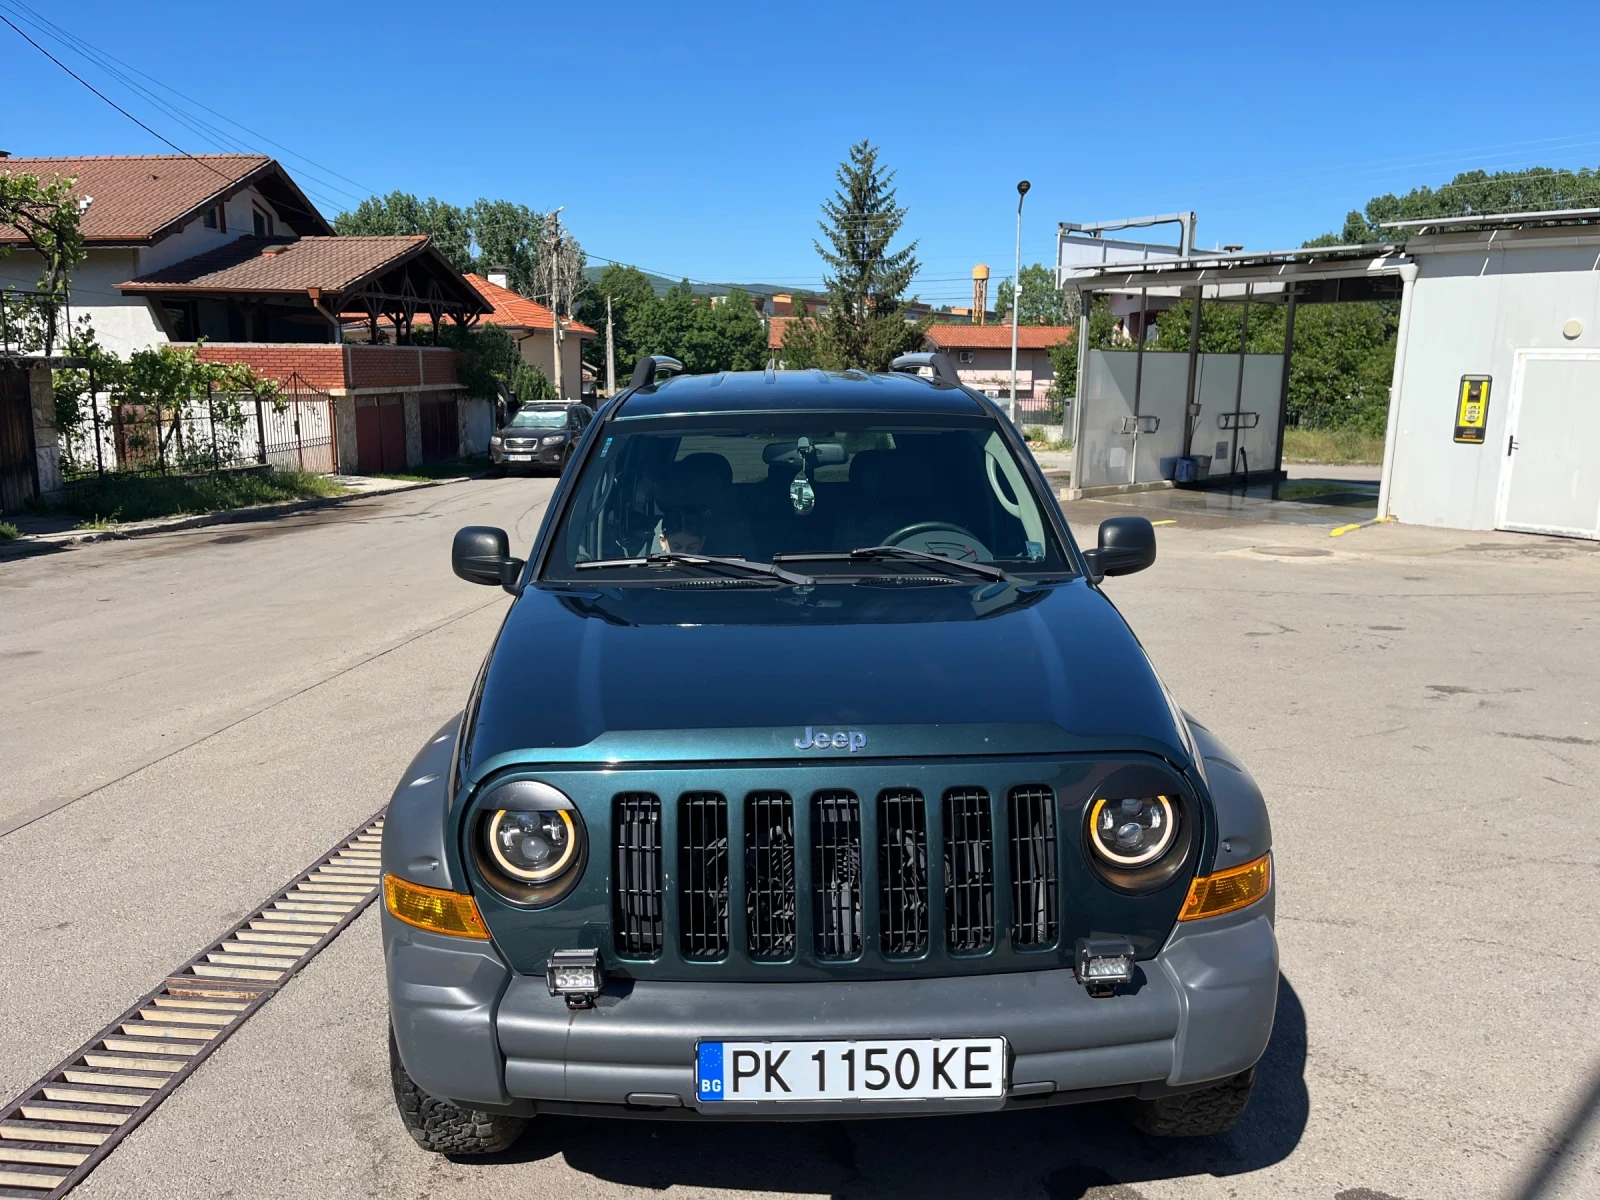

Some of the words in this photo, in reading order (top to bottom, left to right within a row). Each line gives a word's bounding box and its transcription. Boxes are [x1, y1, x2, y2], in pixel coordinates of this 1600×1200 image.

[794, 726, 867, 752] Jeep
[732, 1050, 792, 1093] PK
[811, 1047, 920, 1092] 1150
[932, 1046, 992, 1090] KE
[701, 1079, 722, 1093] BG
